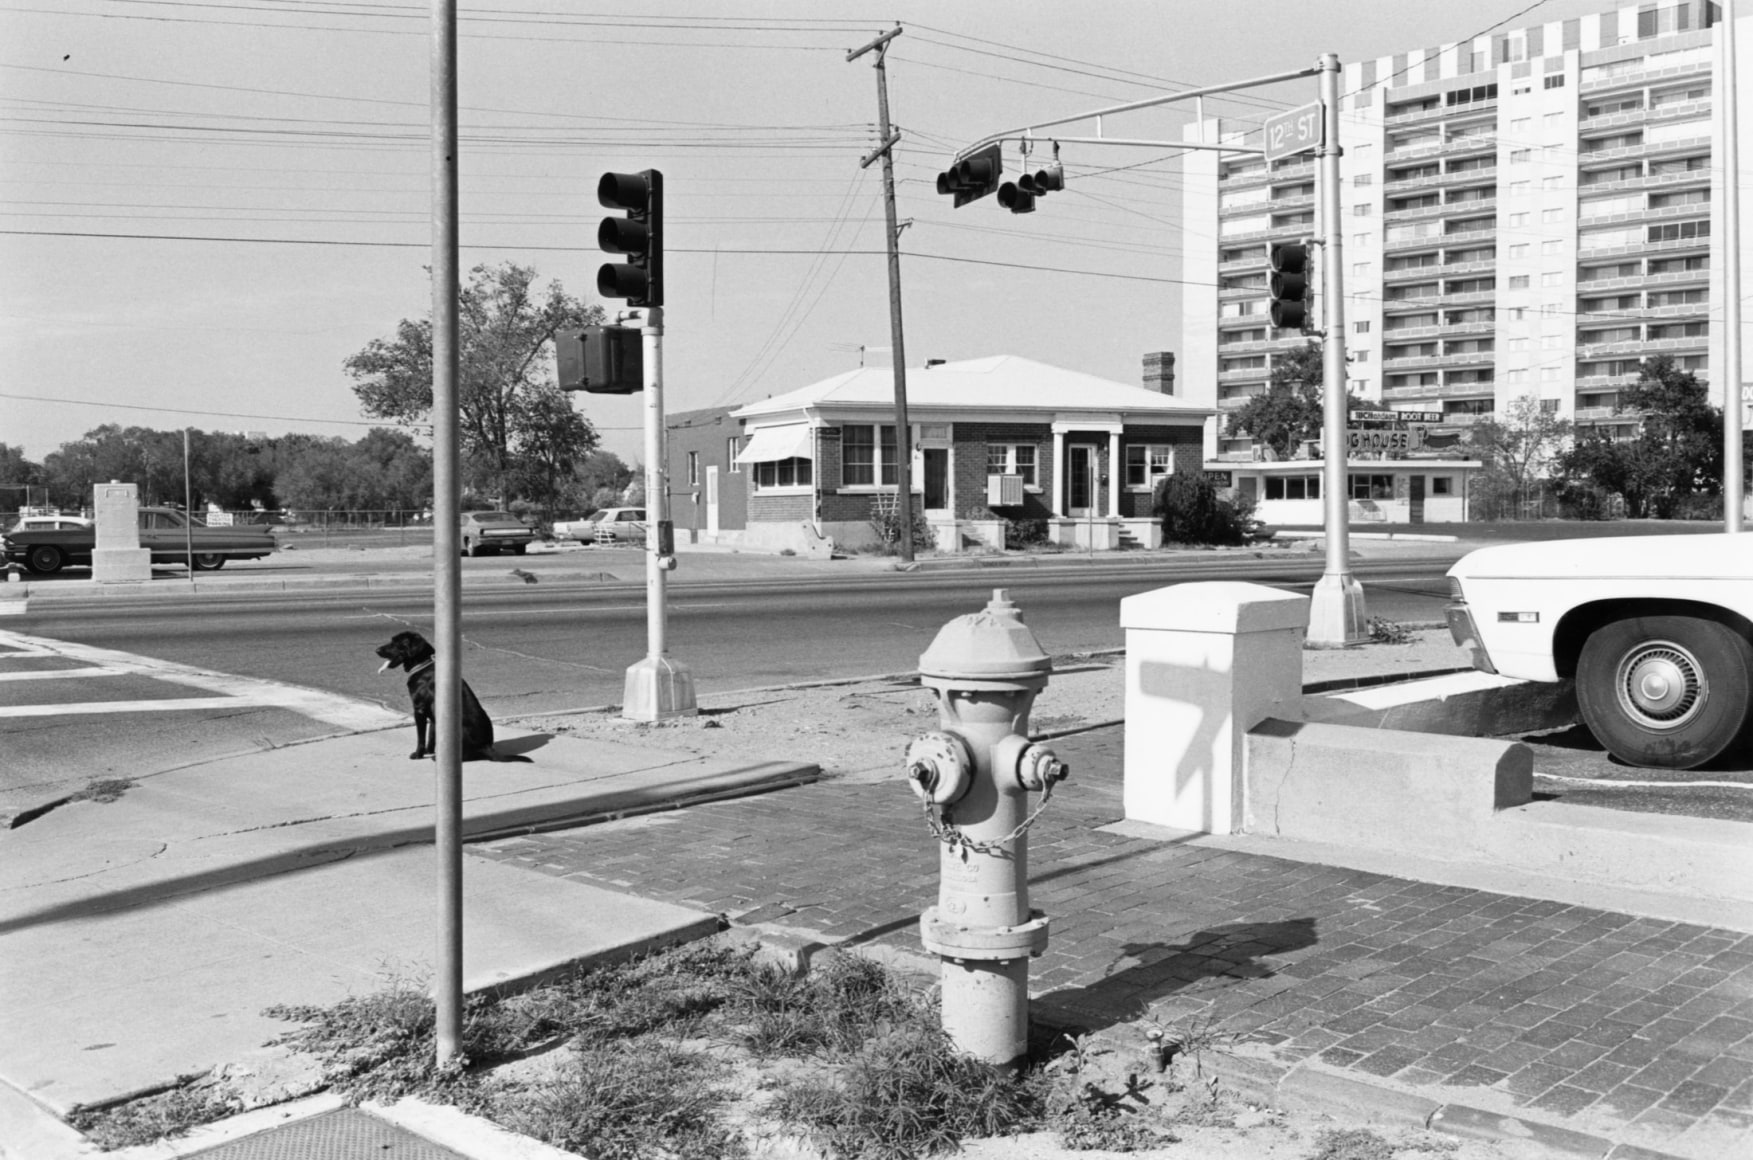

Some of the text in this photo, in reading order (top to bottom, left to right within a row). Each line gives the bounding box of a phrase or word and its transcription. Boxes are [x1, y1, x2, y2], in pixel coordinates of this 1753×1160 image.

[1298, 113, 1316, 140] ST
[1401, 412, 1421, 420] ROOT
[1362, 433, 1408, 448] HOUSE
[1200, 472, 1227, 480] OPEN
